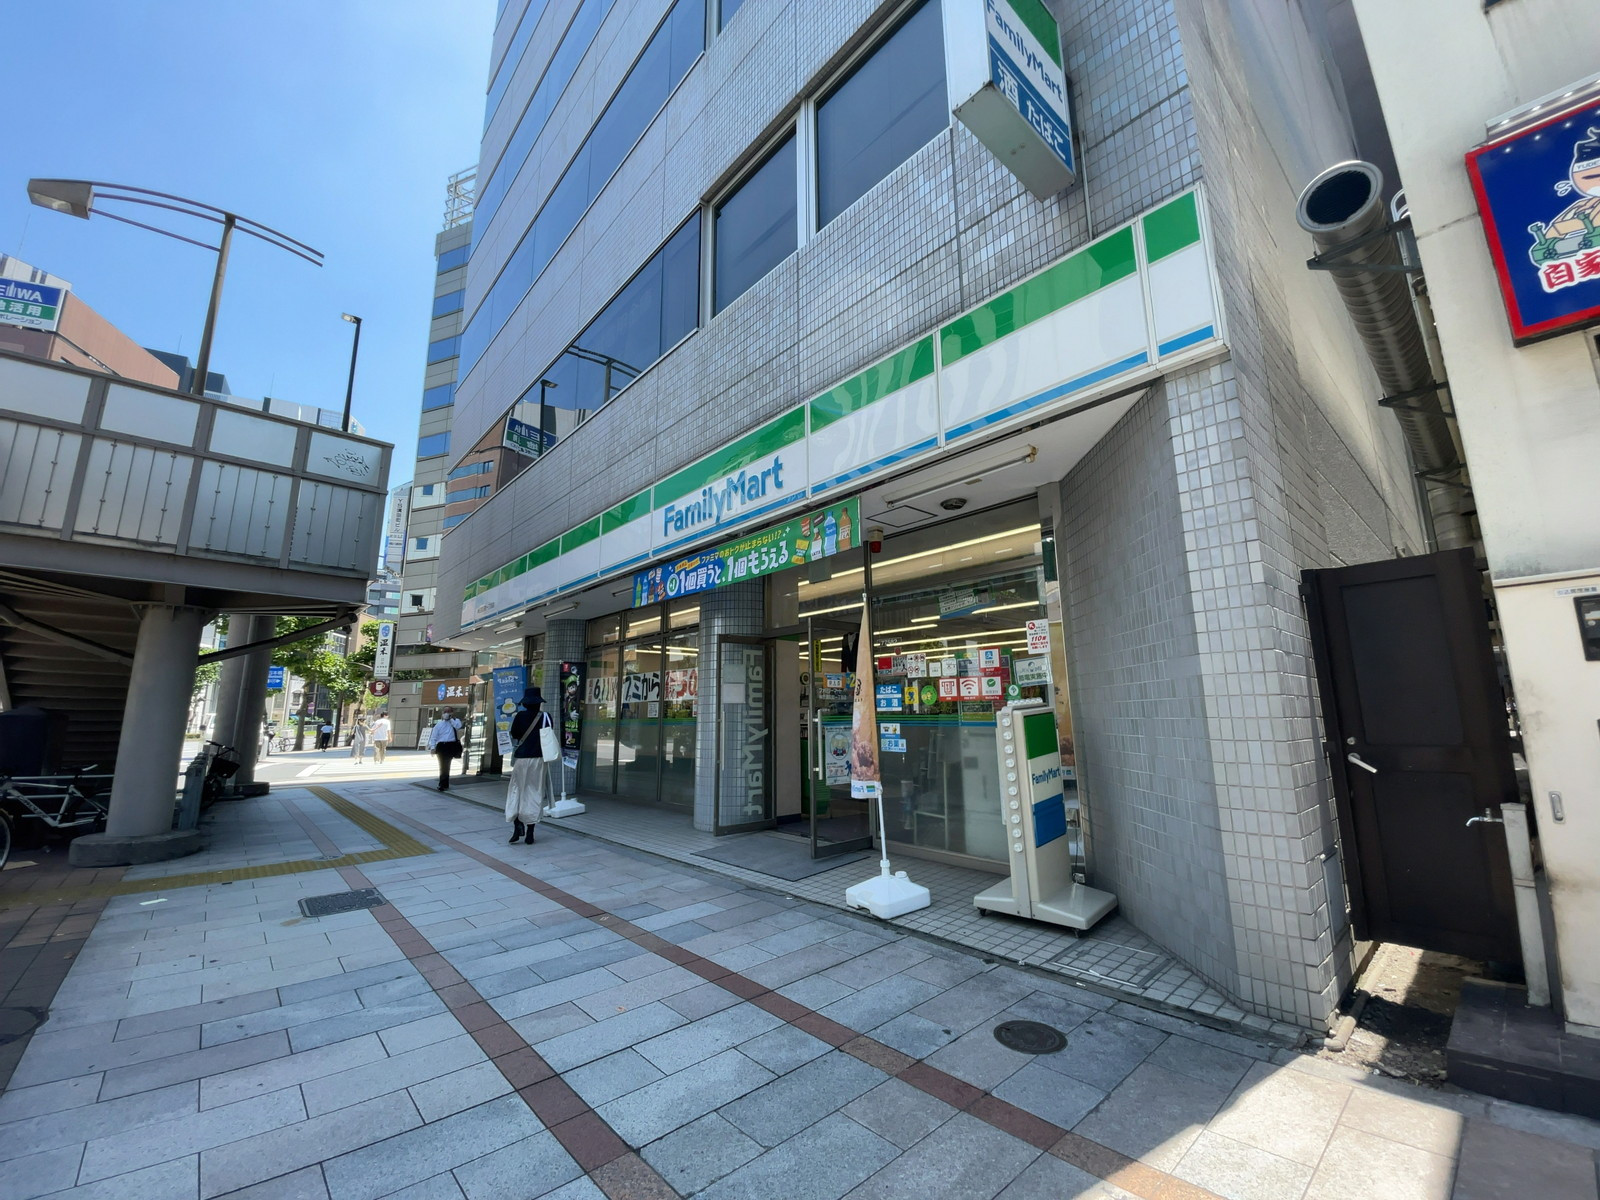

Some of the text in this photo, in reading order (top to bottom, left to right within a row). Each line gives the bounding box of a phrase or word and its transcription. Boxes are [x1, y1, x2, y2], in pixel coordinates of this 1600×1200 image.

[987, 0, 1063, 103] FamilyMart
[998, 60, 1066, 160] 酒 たばこ
[664, 455, 783, 537] FamilyMart
[743, 650, 769, 816] FamilyMart
[880, 686, 898, 694] たばこ
[1032, 767, 1060, 785] FamilyMart
